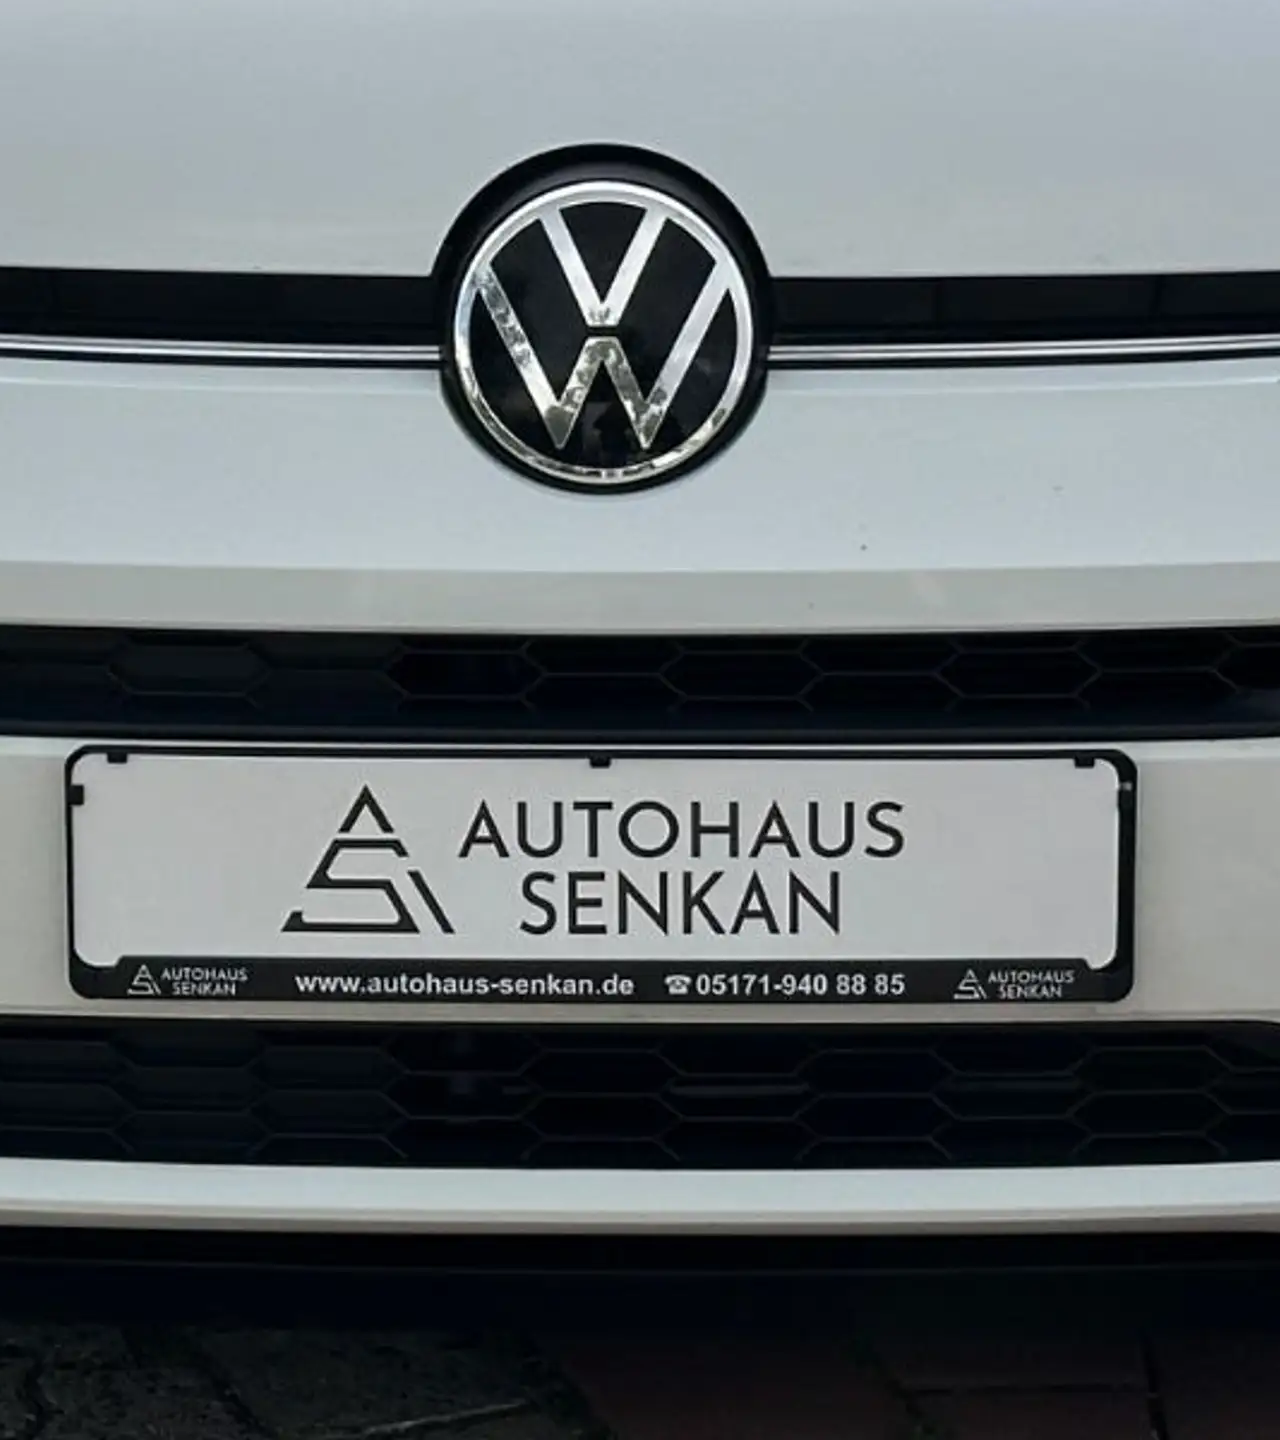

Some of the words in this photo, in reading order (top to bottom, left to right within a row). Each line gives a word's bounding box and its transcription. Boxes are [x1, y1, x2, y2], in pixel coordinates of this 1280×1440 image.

[457, 799, 906, 859] AUTOHAUS
[519, 869, 841, 936] SENKAN
[159, 966, 249, 982] AUTOHAUS
[987, 969, 1076, 984] AUTOHAUS
[171, 981, 237, 996] SENKAN
[294, 972, 636, 997] www.autohaus-senkan.de
[835, 973, 868, 996] 88
[873, 973, 907, 996] 85
[997, 983, 1064, 1000] SENKAN
